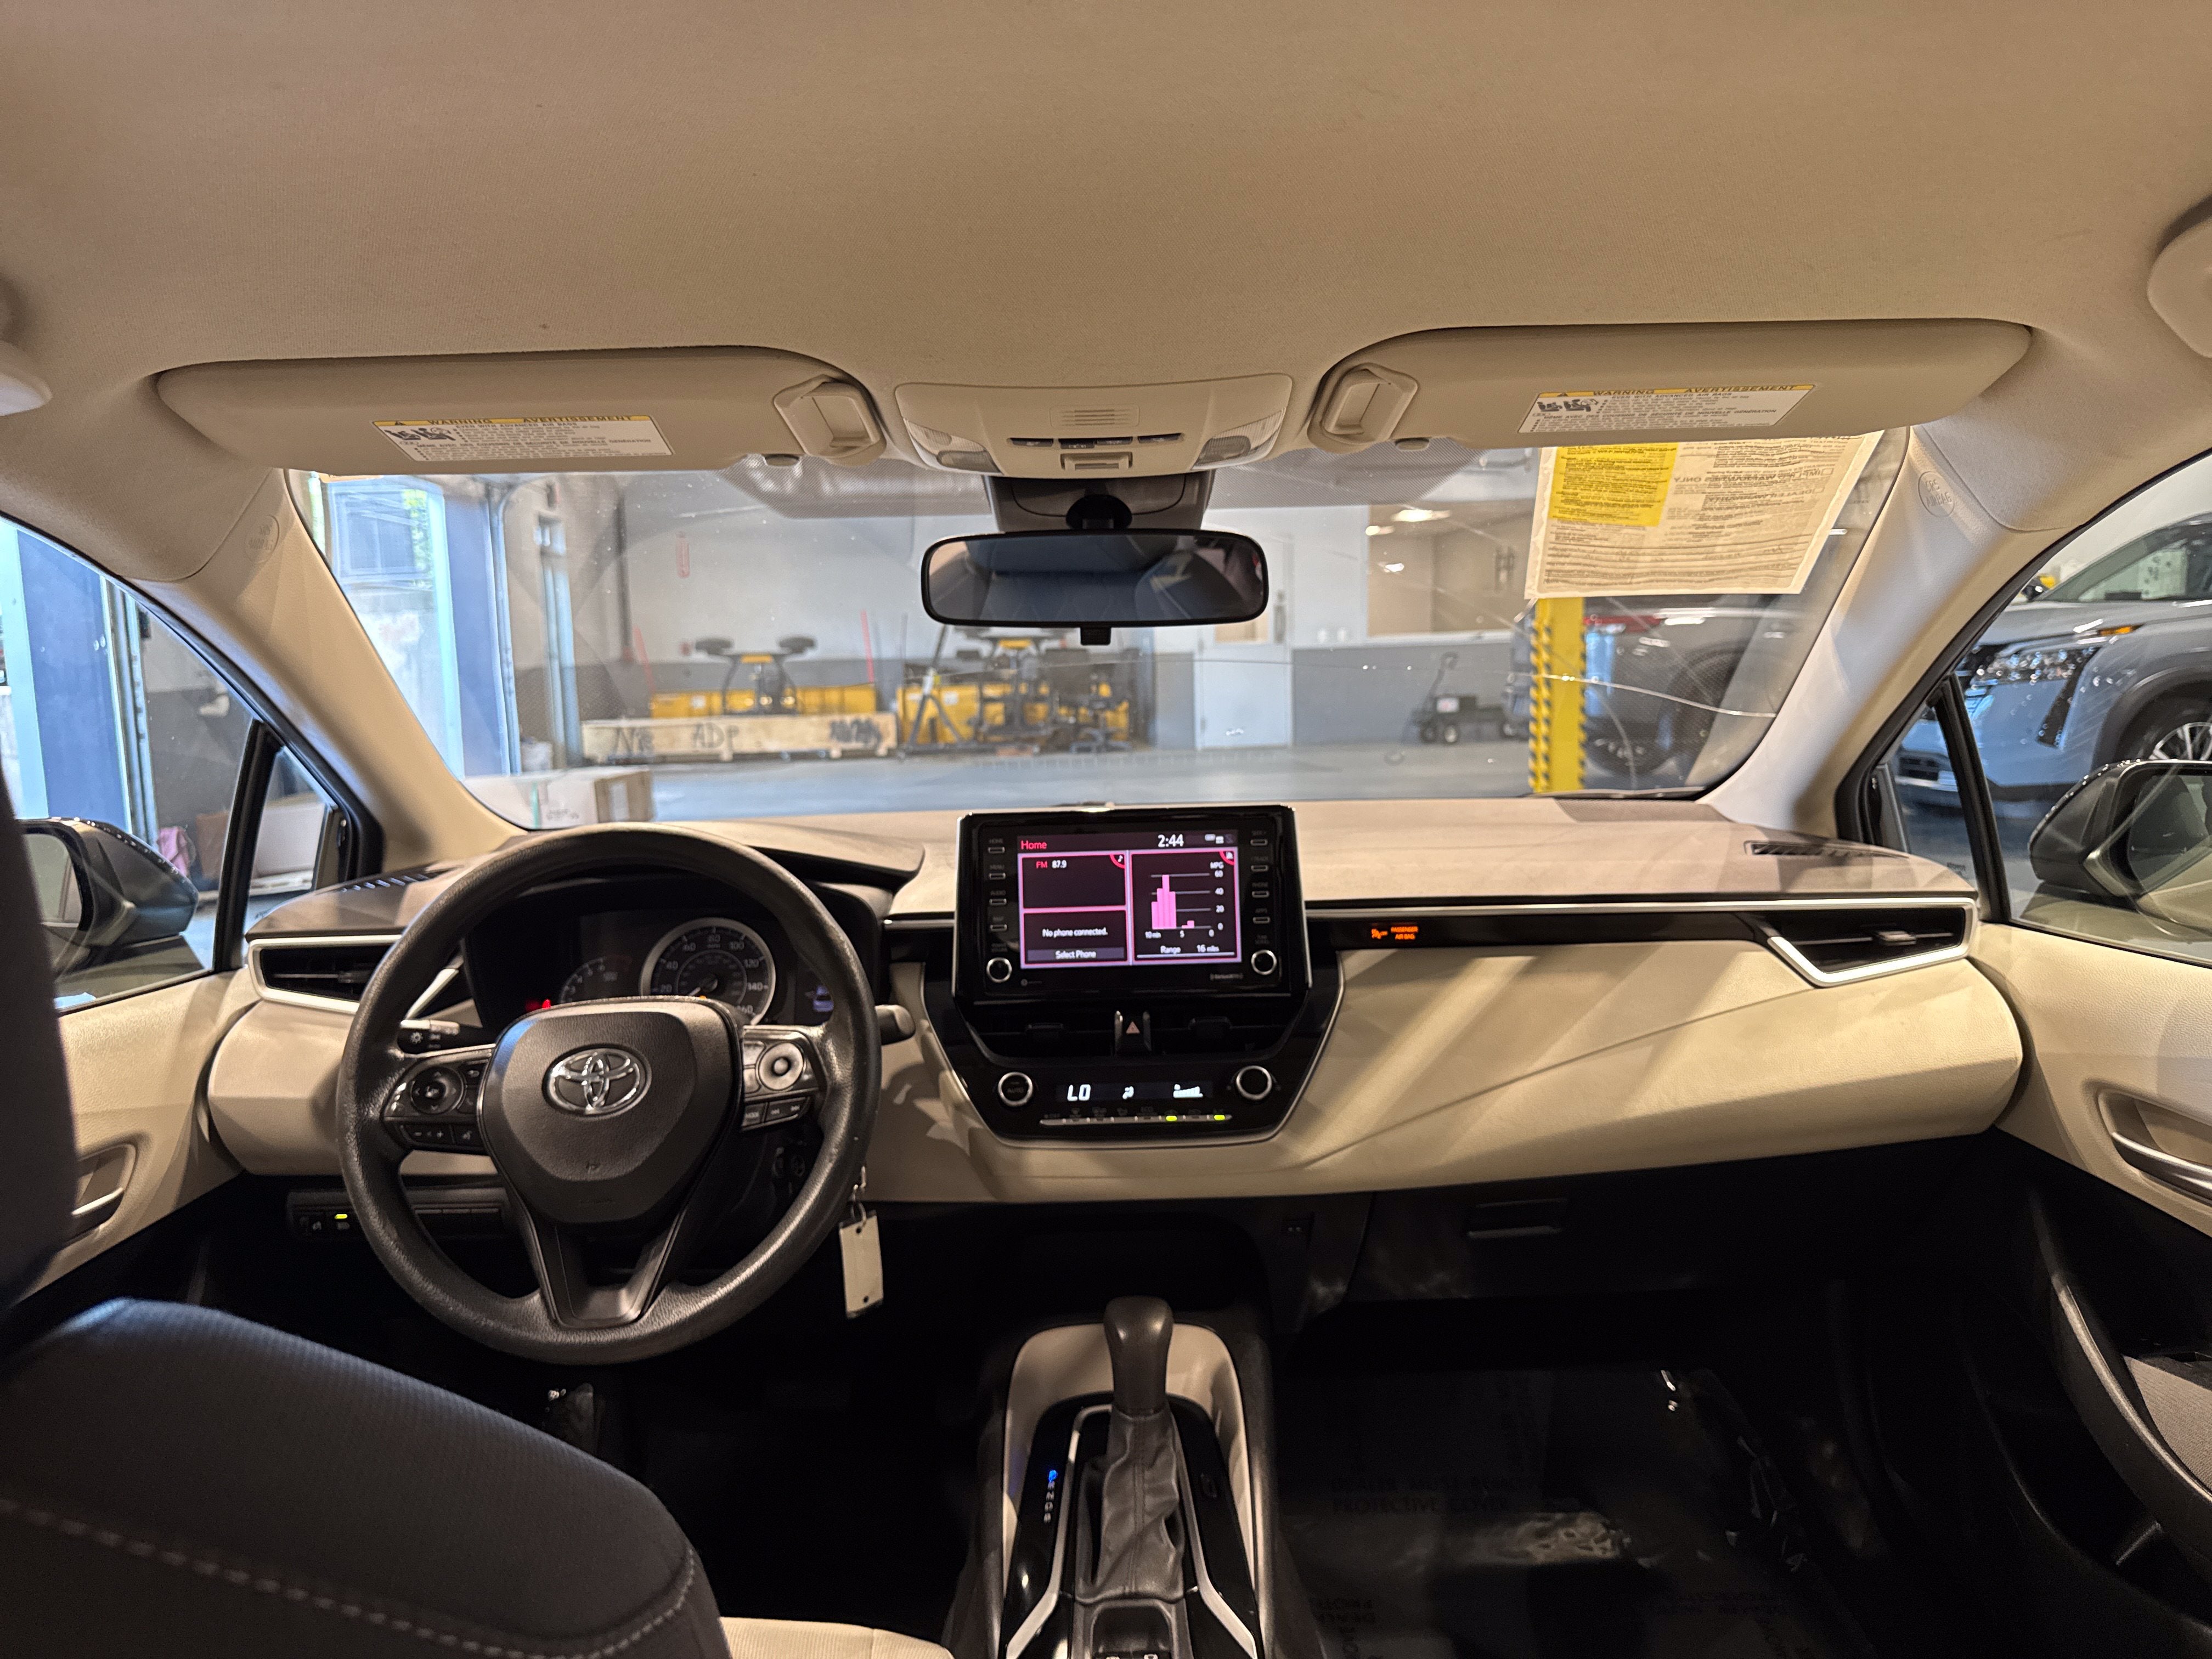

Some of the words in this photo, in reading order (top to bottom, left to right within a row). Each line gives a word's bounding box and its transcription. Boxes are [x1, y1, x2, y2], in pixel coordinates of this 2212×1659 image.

[1926, 493, 1953, 507] AIRBAG
[1020, 840, 1047, 850] Home
[1158, 834, 1184, 847] 2:44
[1052, 860, 1067, 868] 87.9
[1214, 870, 1223, 878] 60
[1217, 922, 1223, 930] 0
[1042, 929, 1053, 937] No
[1053, 929, 1073, 938] phone
[1074, 927, 1108, 936] connected.
[1180, 930, 1184, 938] 5
[1209, 929, 1215, 937] 0
[708, 934, 721, 943] 80
[684, 943, 696, 951] 60
[729, 941, 744, 950] 100
[1160, 945, 1181, 954] Range
[1197, 944, 1206, 952] 16
[1056, 950, 1075, 959] Select
[1076, 950, 1097, 958] Phone
[666, 961, 679, 970] 40
[744, 959, 760, 968] 120
[660, 983, 673, 993] 20
[747, 982, 763, 991] 140
[1067, 1084, 1091, 1101] LO
